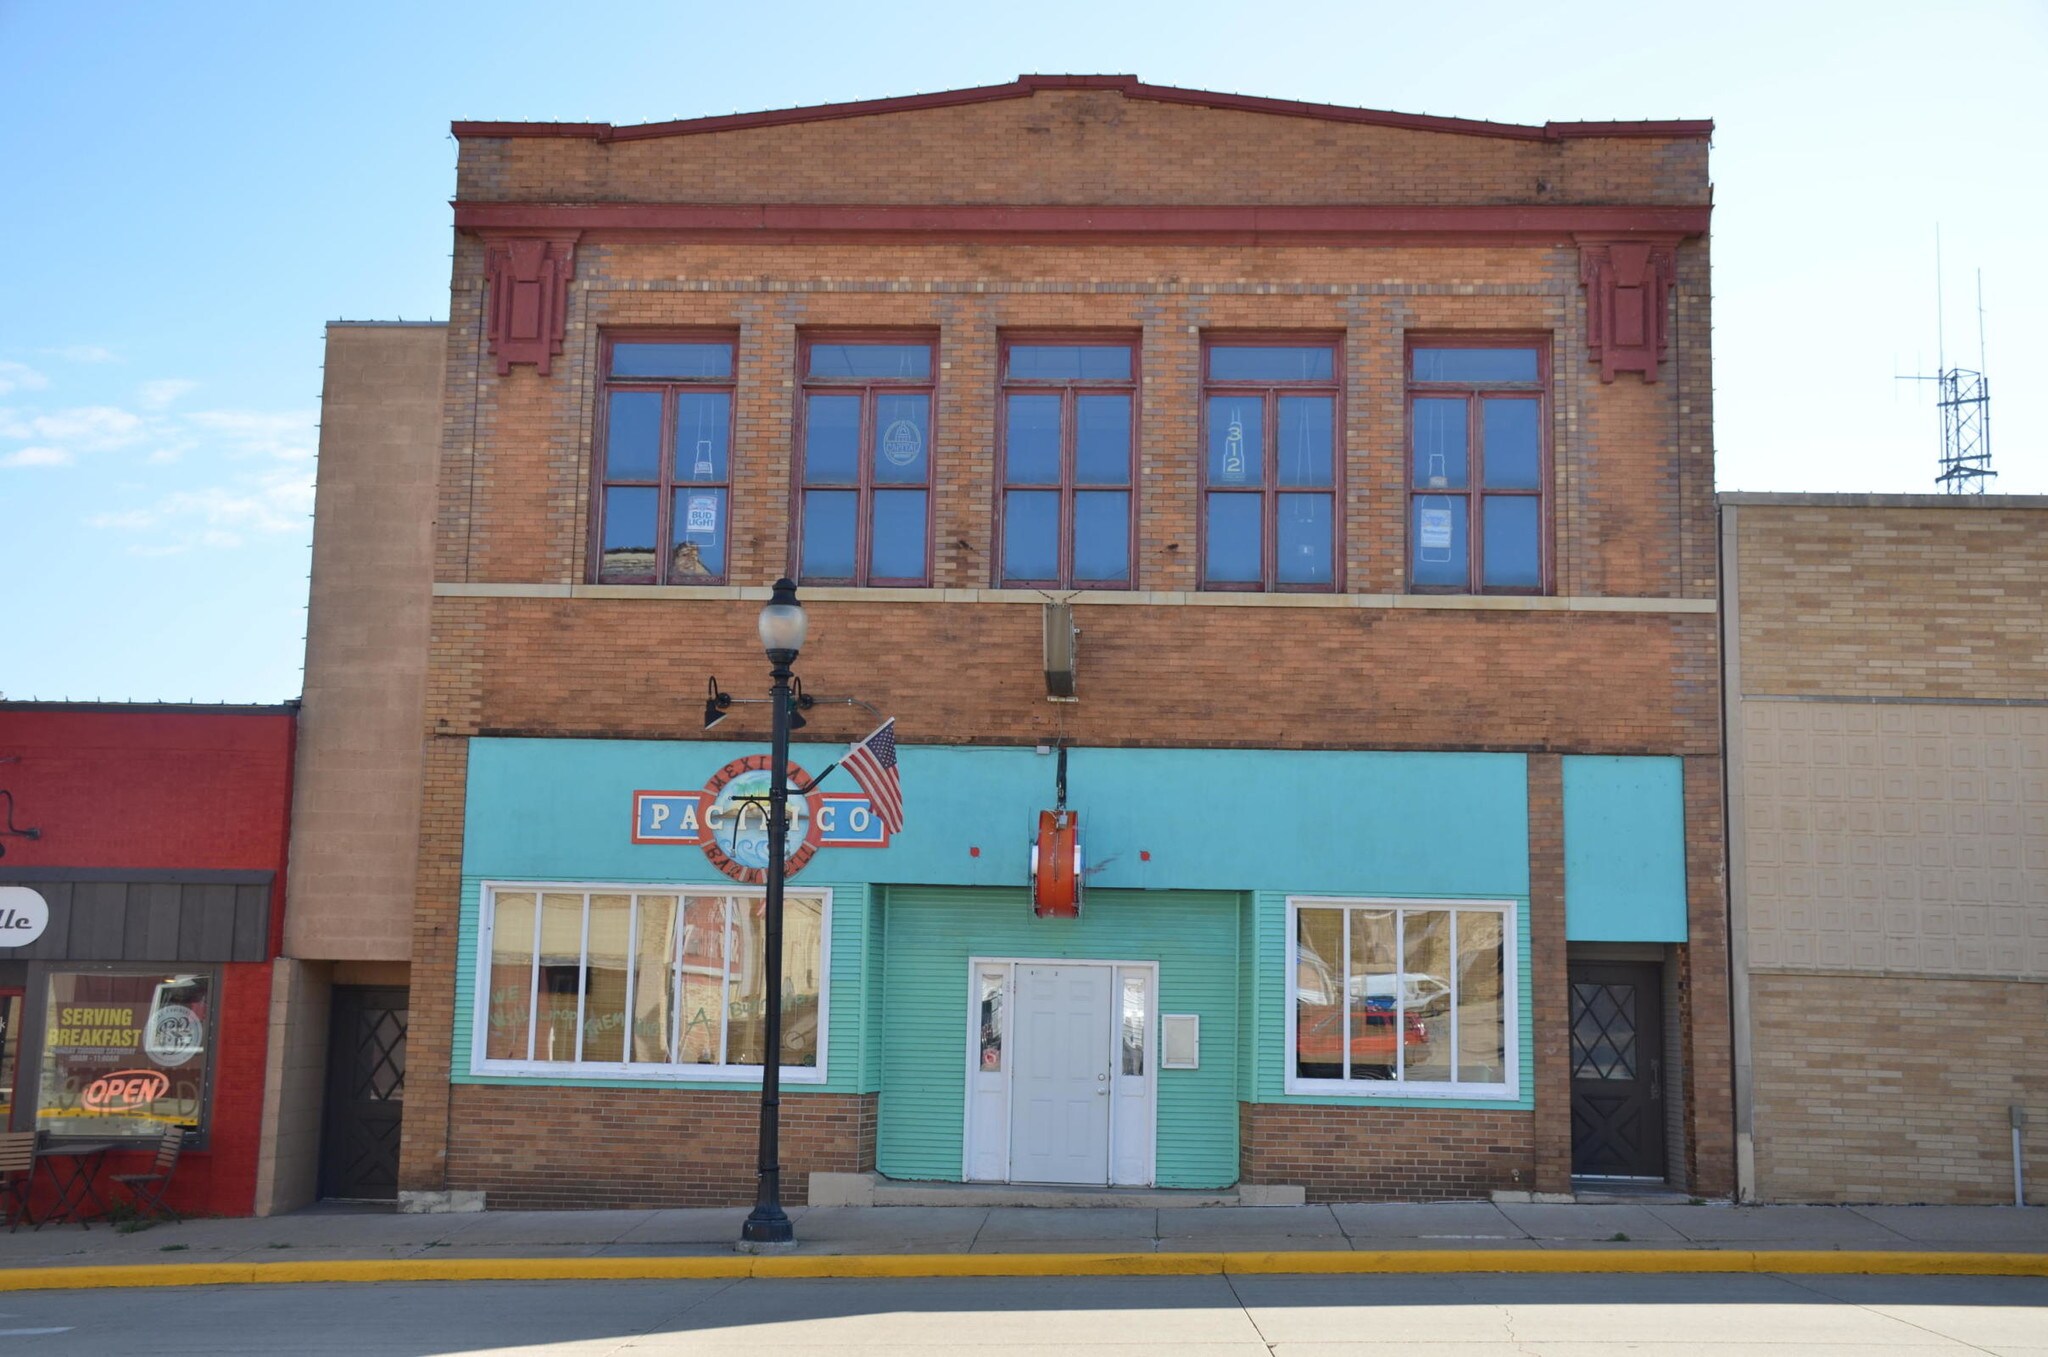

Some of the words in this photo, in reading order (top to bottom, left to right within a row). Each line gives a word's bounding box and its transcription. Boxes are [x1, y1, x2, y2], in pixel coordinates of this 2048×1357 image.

[688, 519, 714, 527] LIGHT
[691, 510, 712, 519] BUD
[61, 1008, 133, 1026] SERVING
[688, 1007, 712, 1036] A
[47, 1029, 142, 1047] BREAKFAST
[87, 1078, 161, 1104] OPEN
